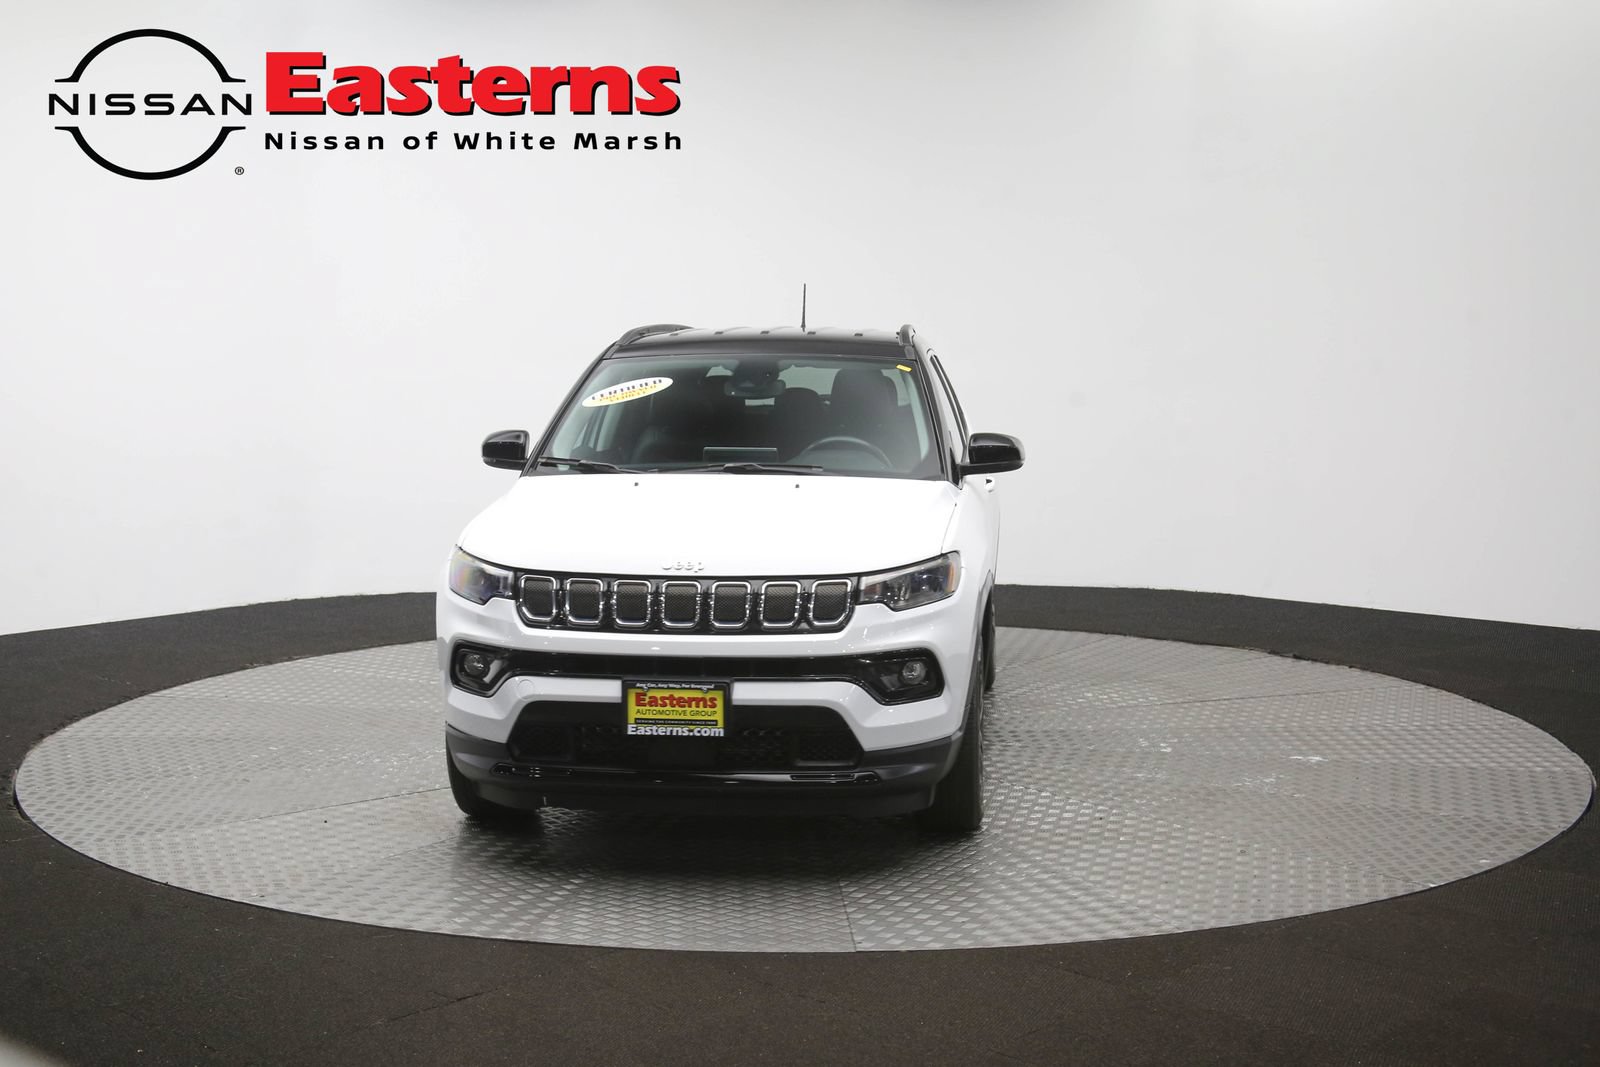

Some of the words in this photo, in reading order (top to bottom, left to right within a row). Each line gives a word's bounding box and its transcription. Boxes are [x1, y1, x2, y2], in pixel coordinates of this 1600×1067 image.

[661, 560, 705, 574] Jeep
[635, 692, 718, 709] Easterns
[635, 709, 688, 717] AUTOMOTIVE
[627, 724, 724, 737] Easterns.com
